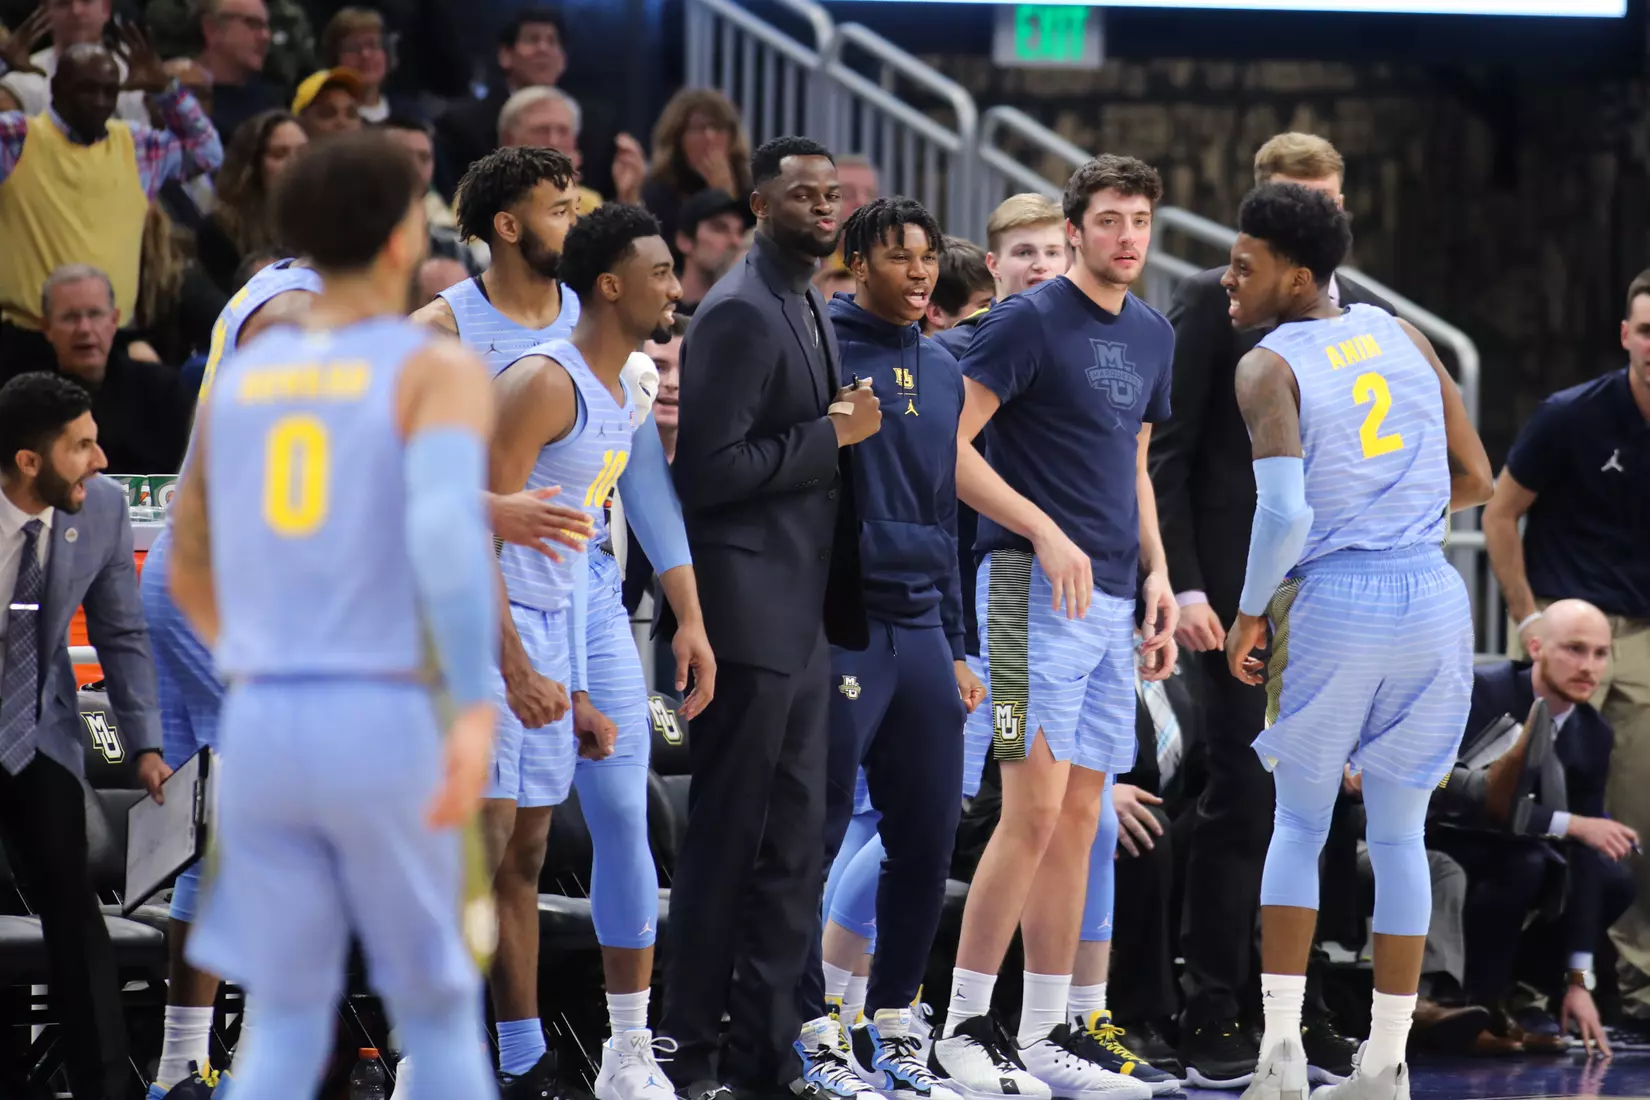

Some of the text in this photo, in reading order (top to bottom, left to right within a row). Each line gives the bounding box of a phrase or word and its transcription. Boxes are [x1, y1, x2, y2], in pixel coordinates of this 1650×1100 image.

[1325, 334, 1382, 370] ANIM
[1352, 371, 1404, 459] 2
[265, 415, 331, 536] 0
[583, 449, 628, 508] 10
[80, 711, 125, 763] MU
[648, 696, 683, 745] MU
[994, 702, 1021, 742] MU
